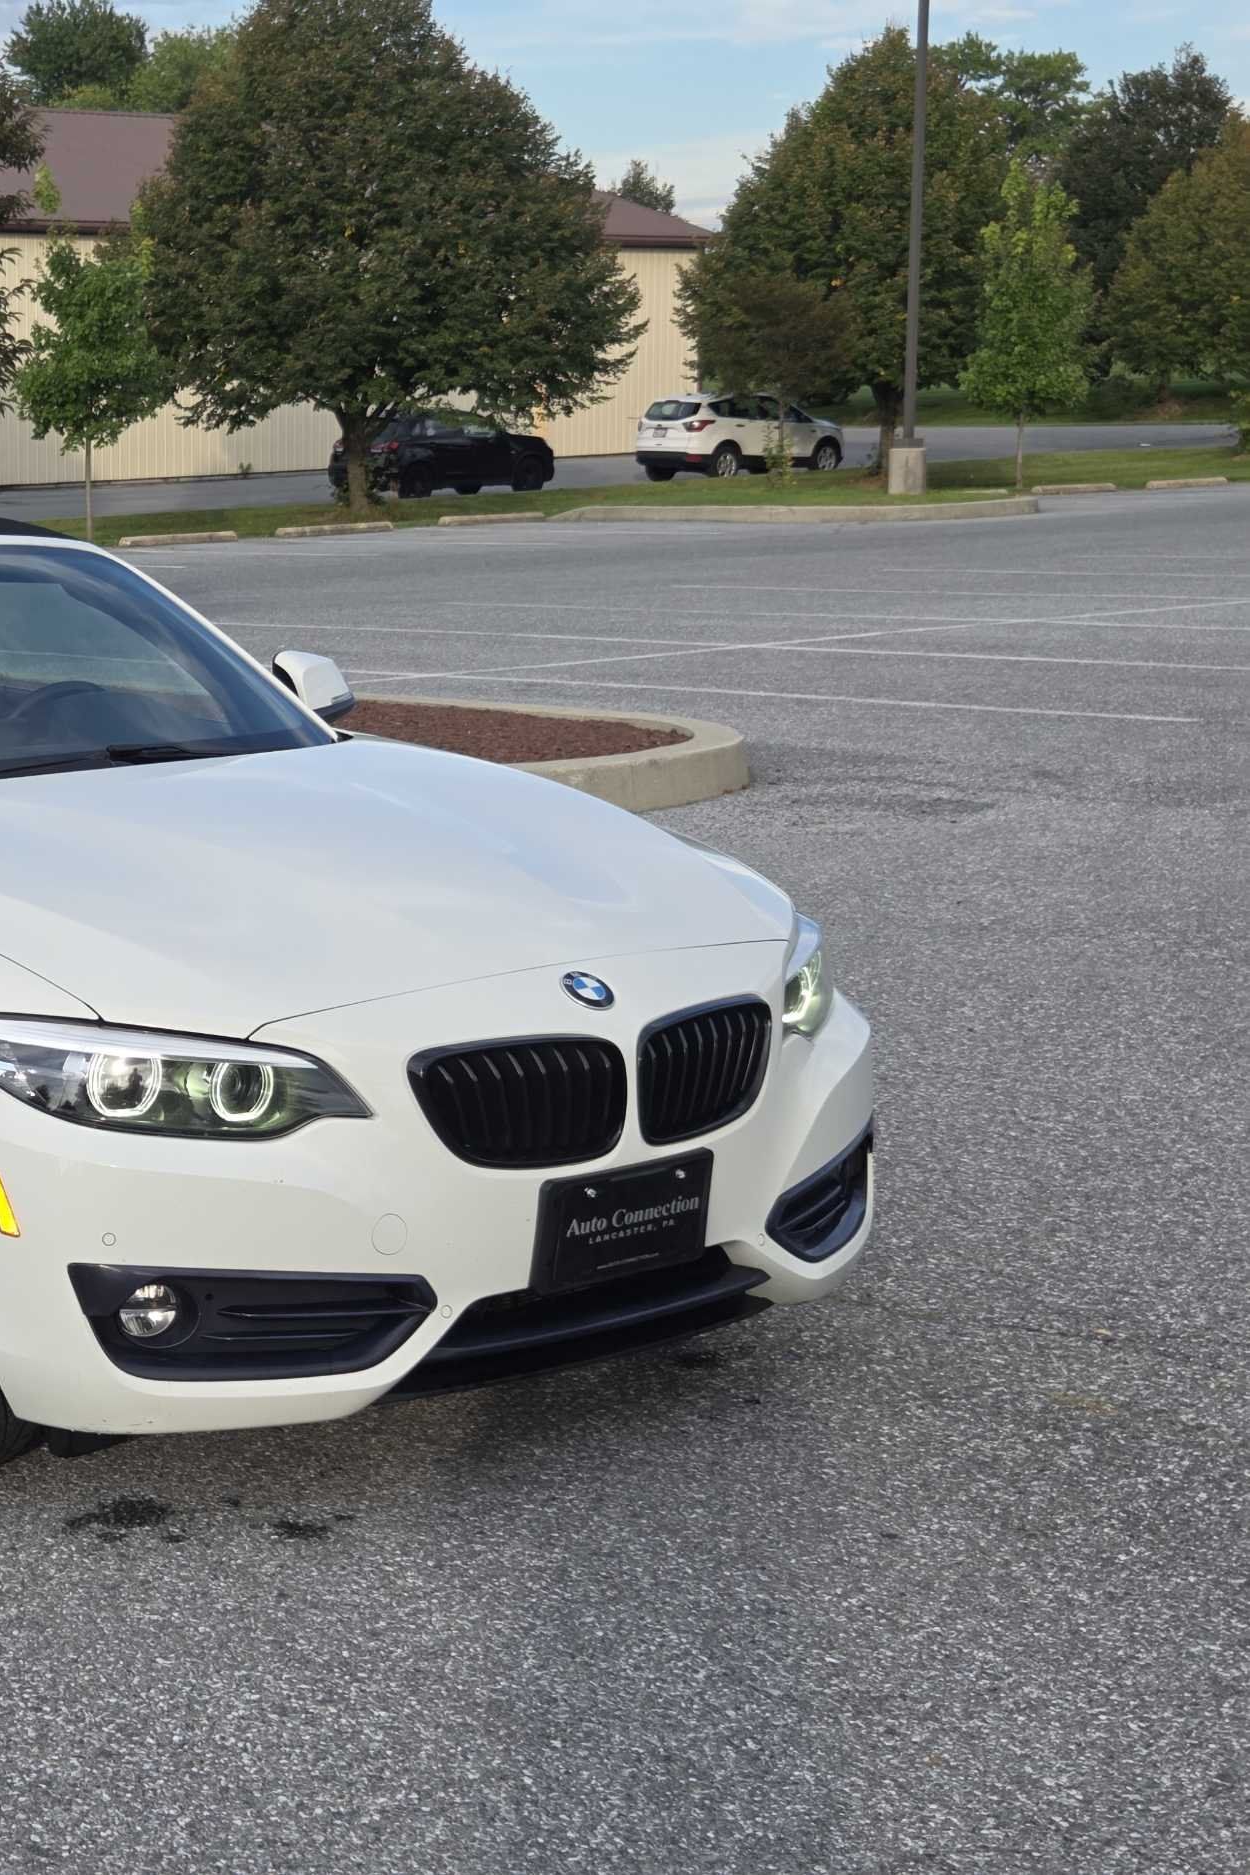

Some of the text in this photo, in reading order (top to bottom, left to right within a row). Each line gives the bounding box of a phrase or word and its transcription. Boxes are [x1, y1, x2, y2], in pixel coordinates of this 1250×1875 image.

[566, 1195, 700, 1238] Auto Connection
[588, 1219, 676, 1245] LANCASTER, PA
